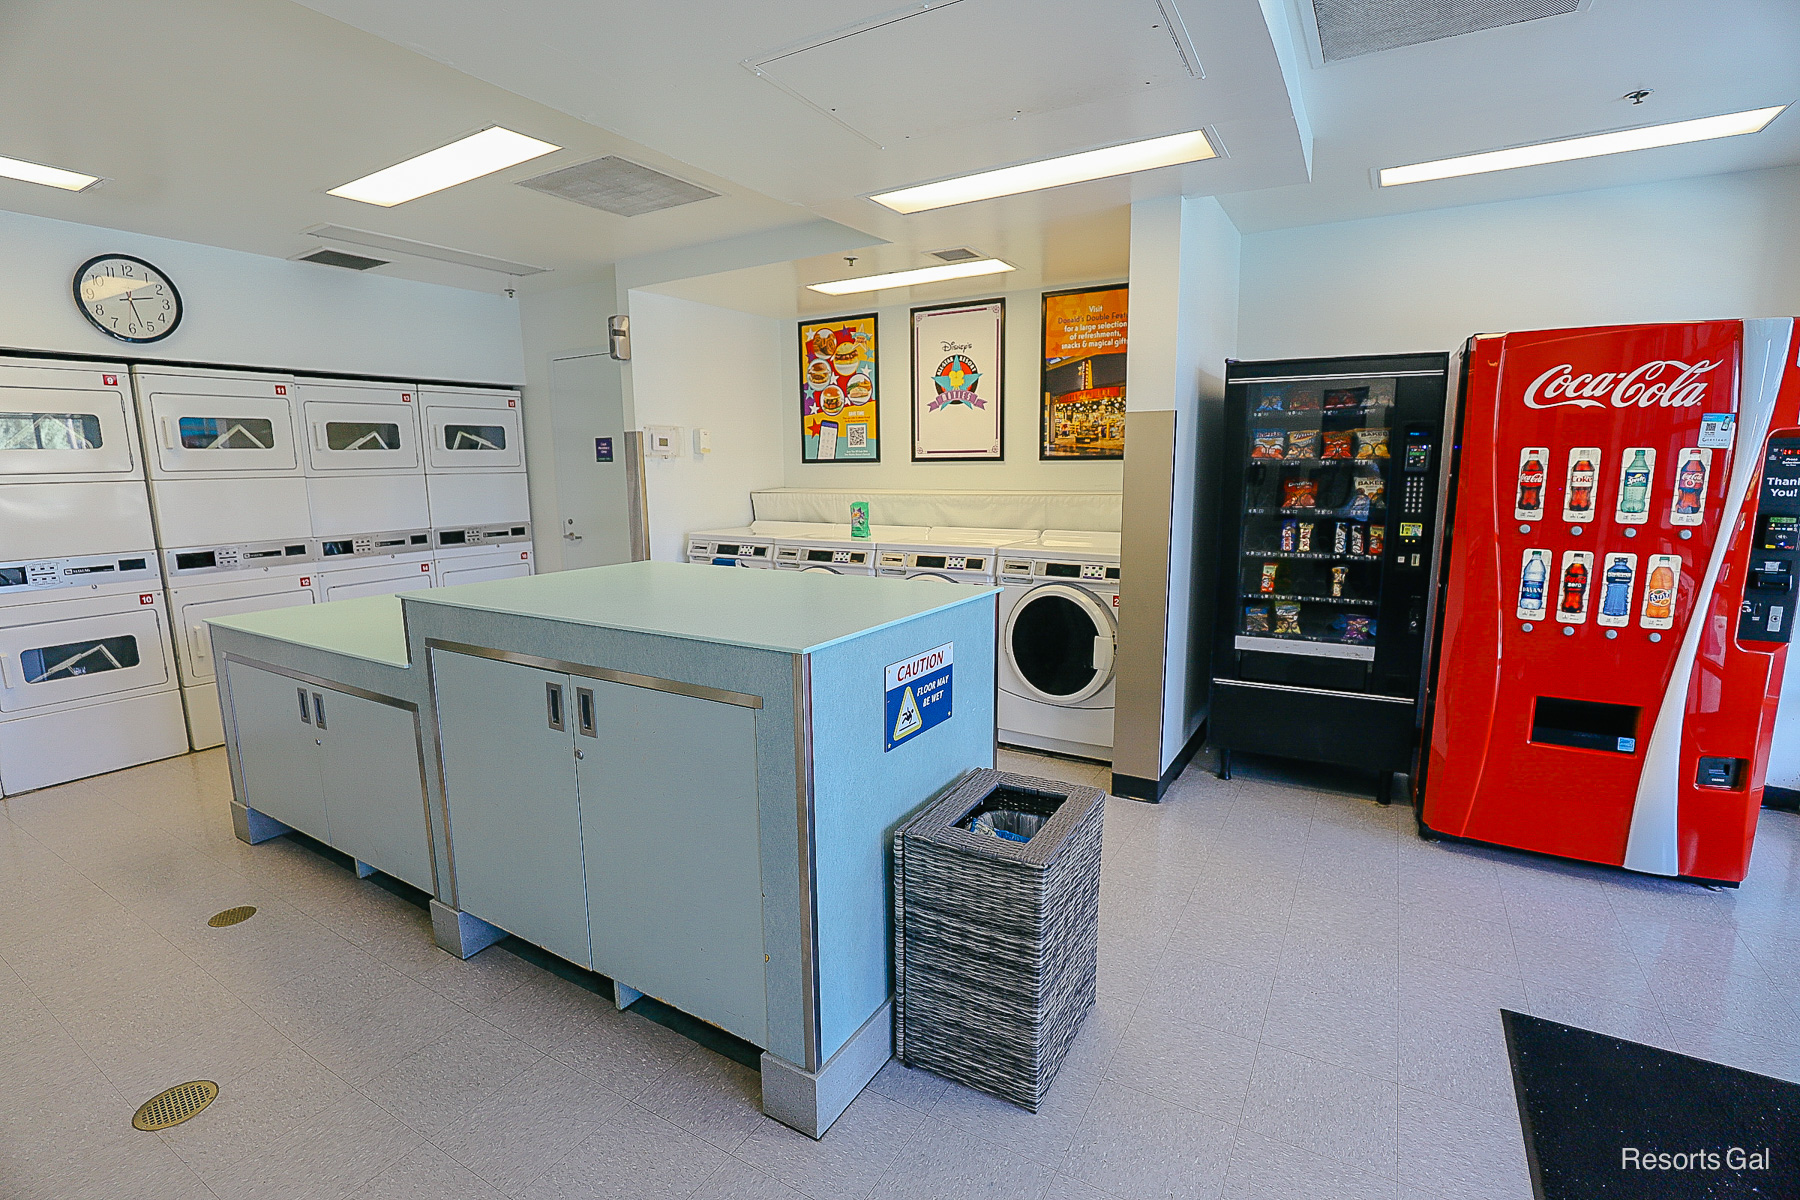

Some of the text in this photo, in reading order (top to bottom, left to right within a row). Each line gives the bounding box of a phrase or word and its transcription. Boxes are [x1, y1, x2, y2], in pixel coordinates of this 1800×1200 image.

[106, 267, 114, 278] 11
[121, 265, 133, 277] 12
[91, 275, 104, 287] 10
[145, 272, 148, 283] 1
[86, 288, 95, 300] 9
[155, 284, 163, 295] 2
[96, 304, 104, 316] 8
[162, 299, 170, 310] 3
[1088, 305, 1103, 313] Visit
[111, 317, 118, 328] 7
[158, 313, 165, 323] 4
[1058, 315, 1084, 324] Donald's
[1086, 313, 1110, 322] Double
[129, 323, 136, 334] 6
[147, 321, 154, 332] 5
[1080, 324, 1096, 332] large
[1098, 321, 1127, 329] selection
[1078, 330, 1122, 340] refreshments,
[940, 341, 972, 353] Disney's
[1061, 341, 1080, 350] snacks
[1082, 340, 1087, 348] &
[1088, 339, 1113, 348] magical
[959, 356, 976, 372] RESORT
[1523, 359, 1724, 409] Coca-Cola
[1571, 475, 1593, 483] Coke
[1627, 475, 1646, 486] Sprite
[1771, 488, 1798, 497] You!
[897, 650, 944, 681] CAUTION
[917, 674, 950, 697] FLOOR MAY
[923, 690, 944, 707] BE WET
